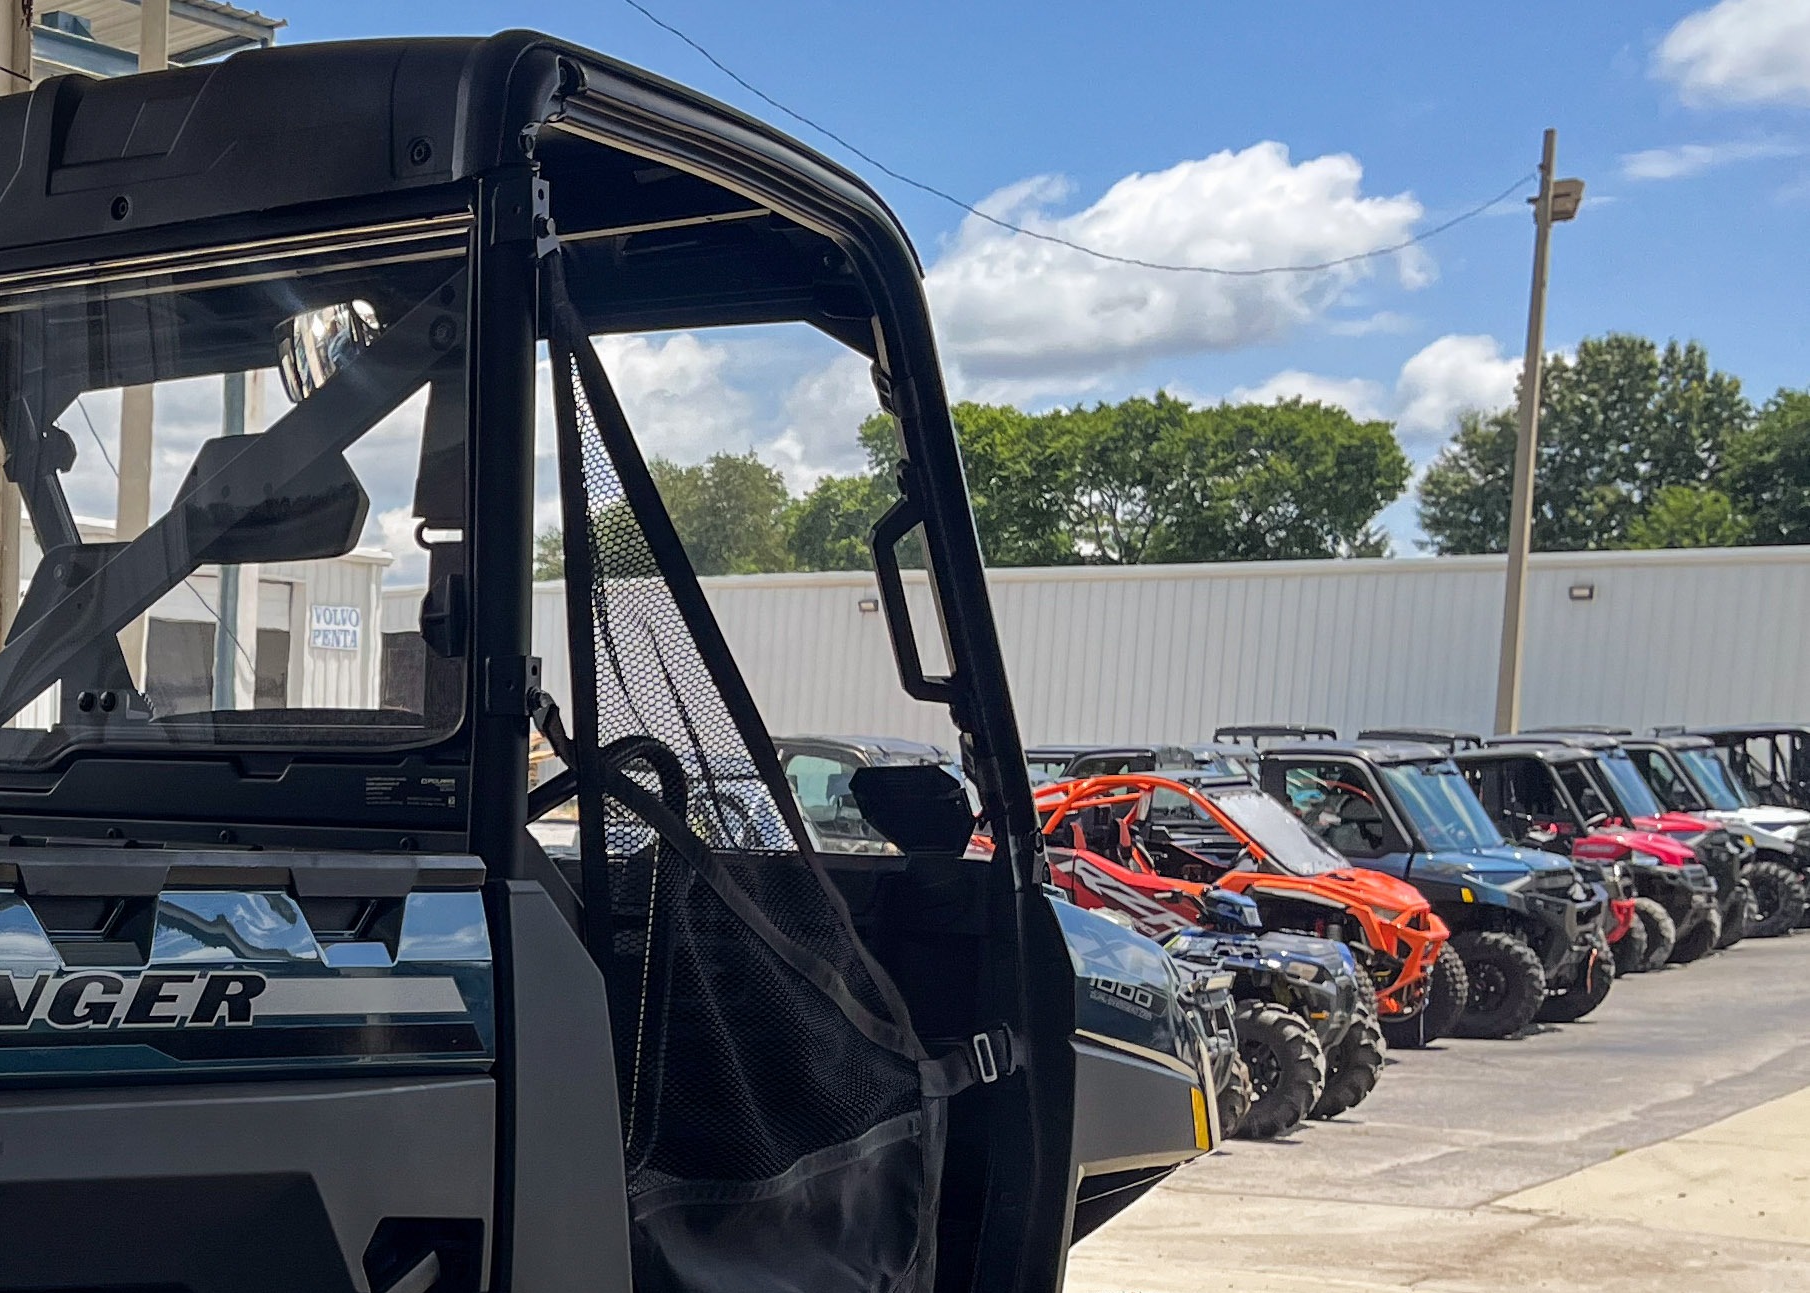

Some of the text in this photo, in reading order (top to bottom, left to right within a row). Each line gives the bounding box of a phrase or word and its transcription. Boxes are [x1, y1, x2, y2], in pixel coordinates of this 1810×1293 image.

[314, 607, 359, 627] VOLVO
[313, 629, 358, 648] PENTA
[1089, 972, 1154, 1009] 1000
